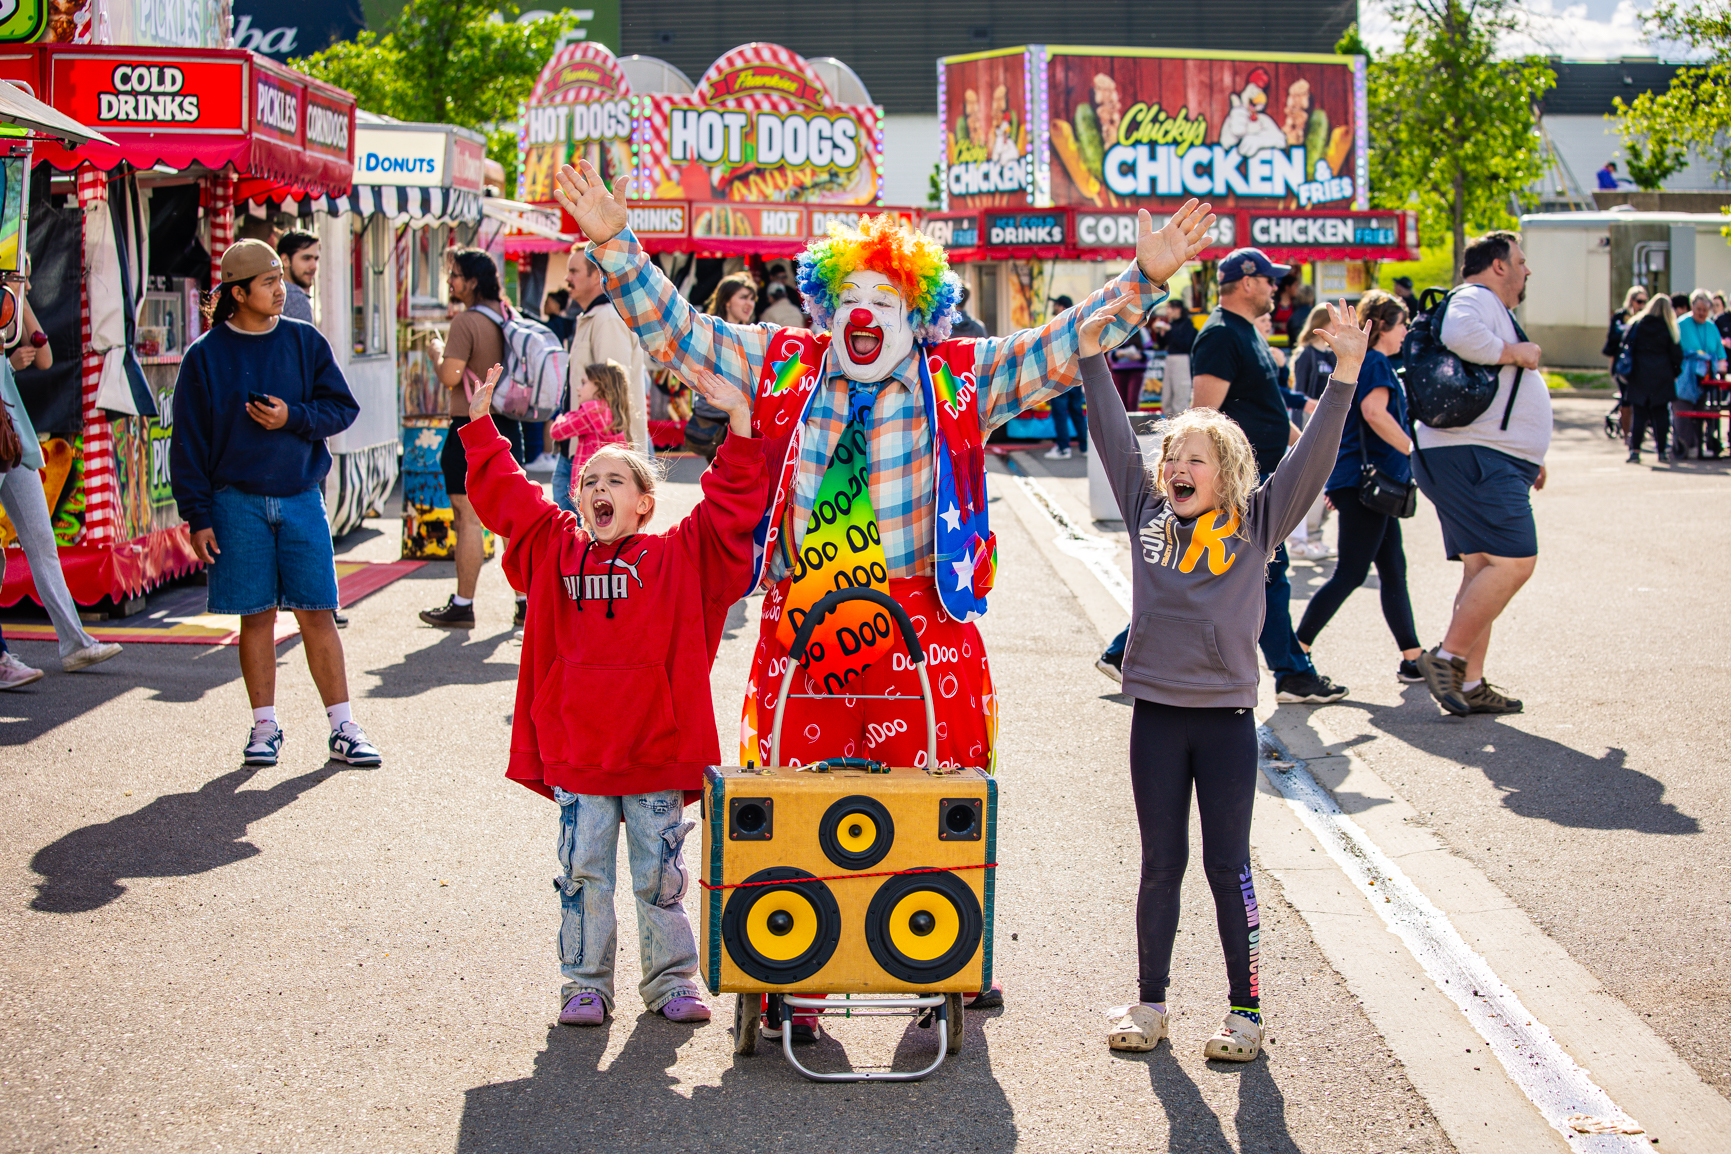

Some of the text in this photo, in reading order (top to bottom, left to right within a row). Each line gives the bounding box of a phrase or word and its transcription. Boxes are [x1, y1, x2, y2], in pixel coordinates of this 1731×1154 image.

[113, 66, 183, 93] COLD
[98, 93, 200, 121] DRINKS
[257, 82, 298, 133] PICKLES
[529, 98, 632, 144] HOT DOGS
[306, 103, 349, 150] CORNDOGS
[670, 109, 858, 169] HOT DOGS
[1118, 101, 1207, 157] Chicky's
[948, 157, 1027, 195] CHICKEN
[1103, 143, 1306, 196] CHICKEN
[1314, 158, 1332, 182] &
[1297, 175, 1354, 207] FRIES
[761, 210, 800, 236] HOT
[990, 226, 1063, 244] DRINKS
[1079, 216, 1139, 245] COR
[1252, 217, 1355, 244] CHICKEN
[1178, 505, 1241, 576] R
[562, 573, 628, 601] PUMA
